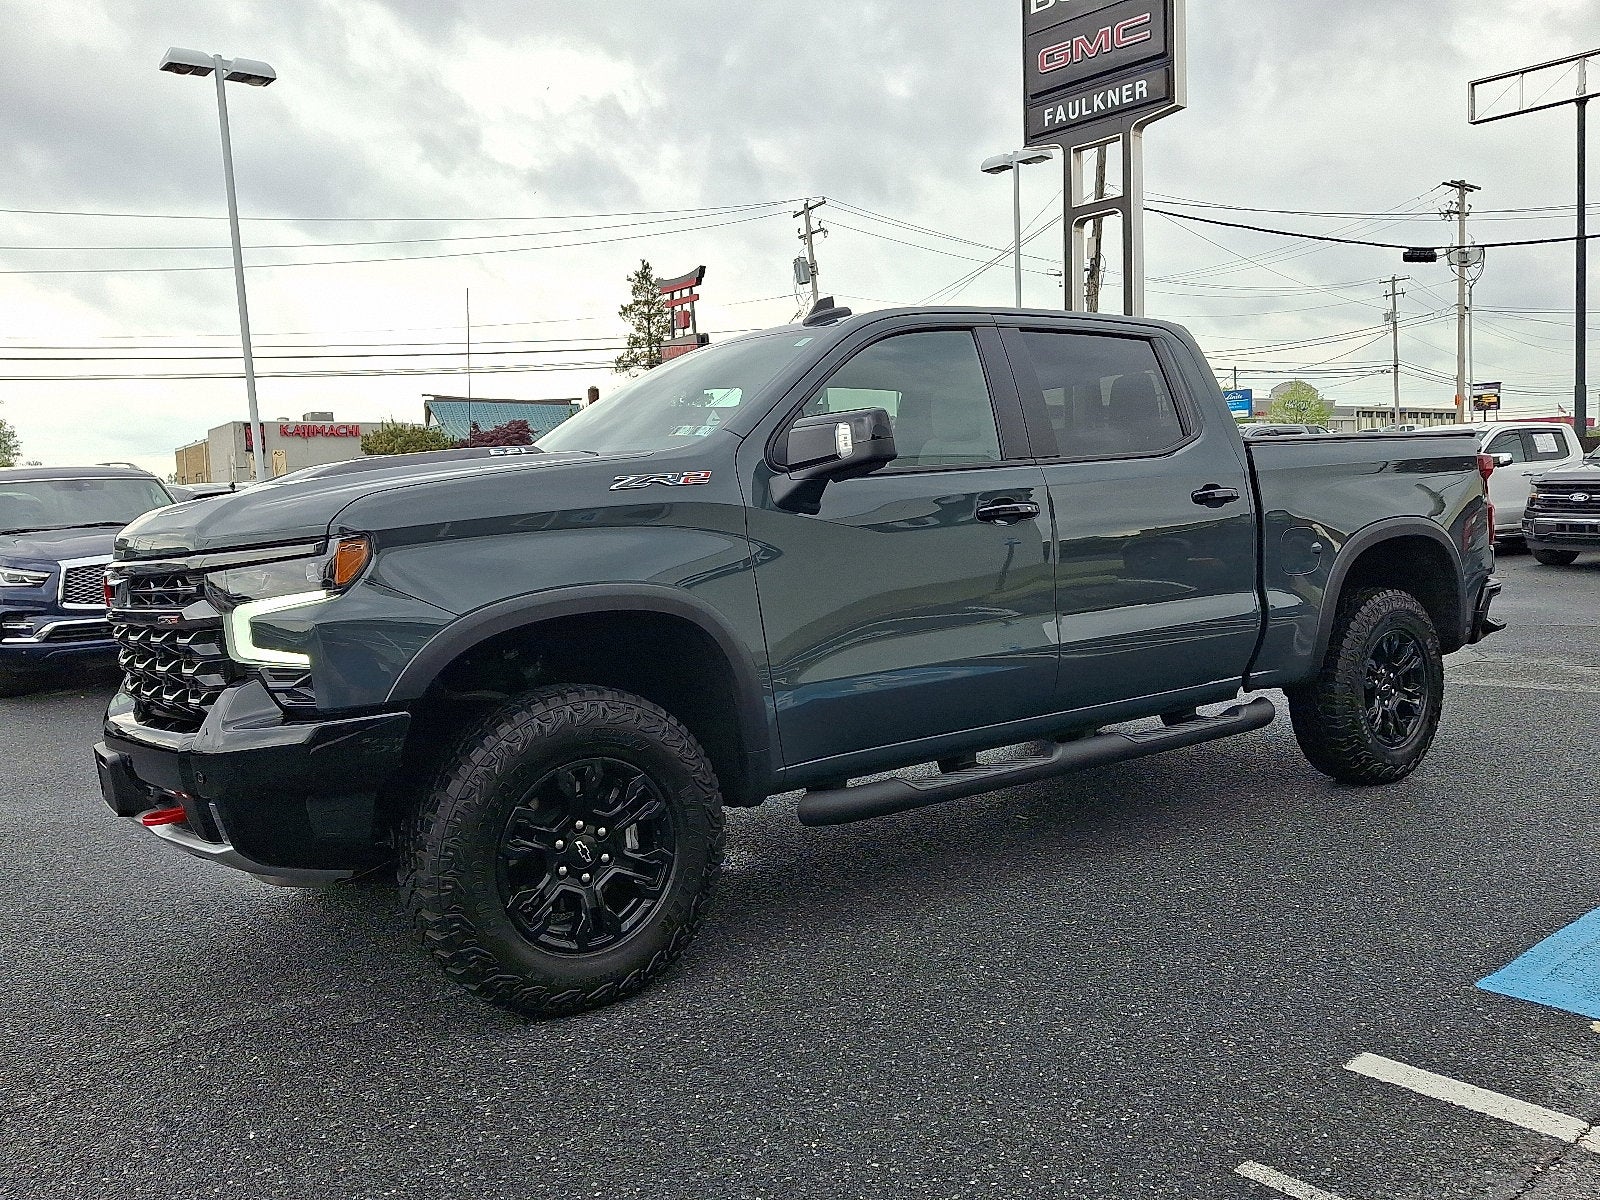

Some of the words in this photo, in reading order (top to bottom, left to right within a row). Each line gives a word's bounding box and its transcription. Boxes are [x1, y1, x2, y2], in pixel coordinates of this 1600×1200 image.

[1038, 13, 1151, 73] GMC
[1044, 79, 1148, 127] FAULKNER
[280, 424, 360, 438] KAJIMACHI
[609, 470, 712, 490] ZR2
